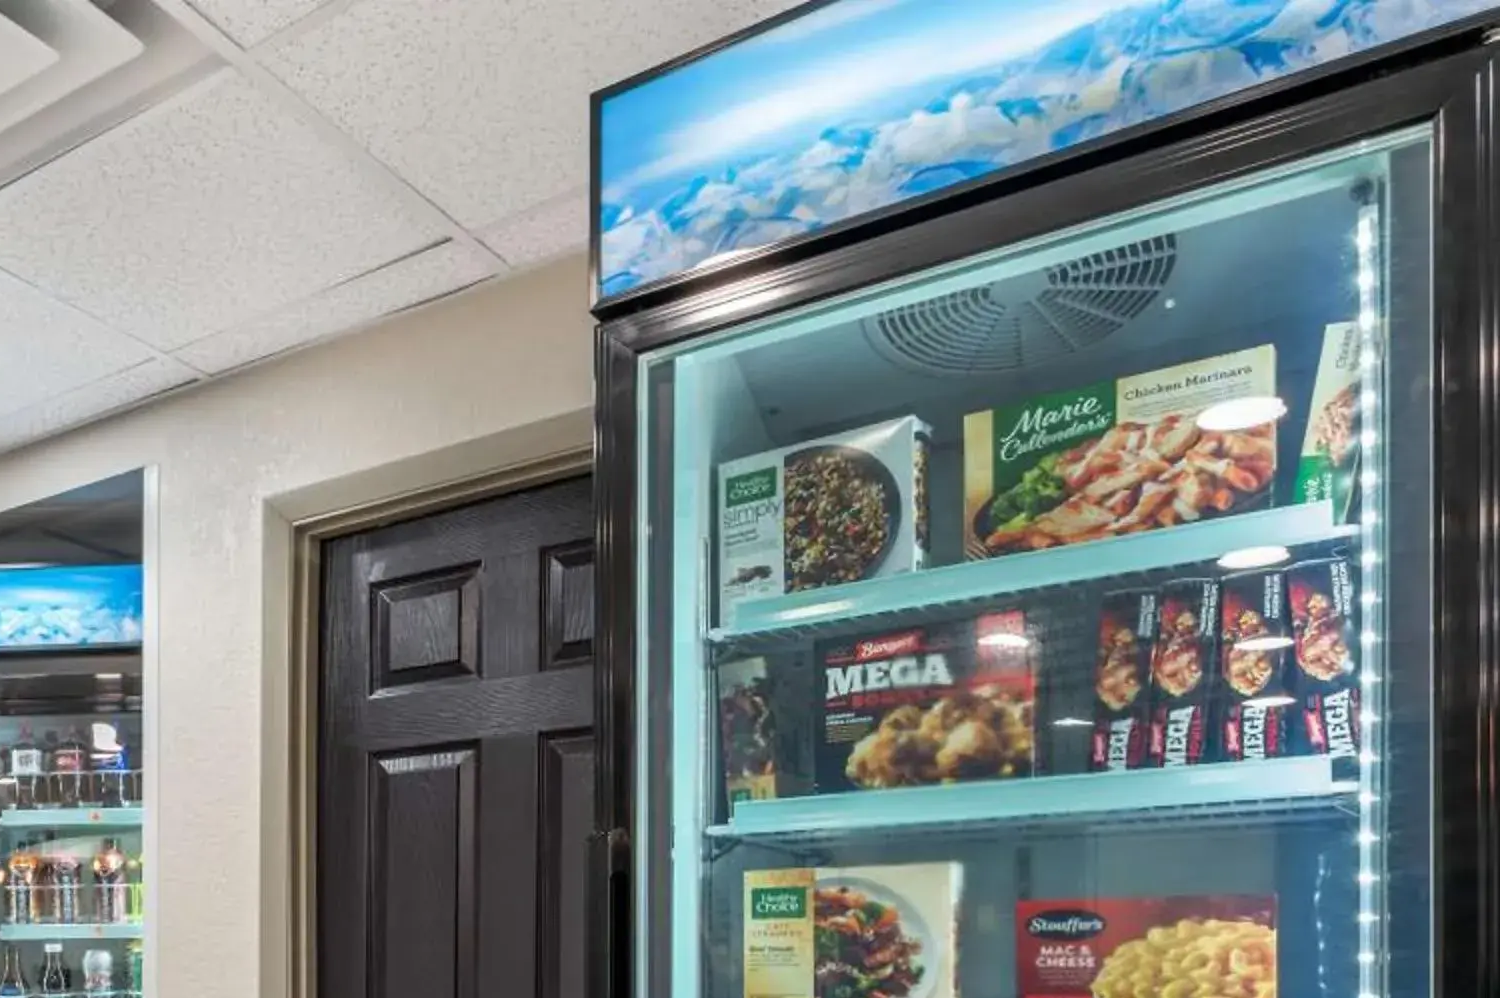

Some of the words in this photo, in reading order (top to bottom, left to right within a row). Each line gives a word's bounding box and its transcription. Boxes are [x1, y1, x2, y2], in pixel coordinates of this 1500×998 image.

[1124, 382, 1182, 401] Chicken
[1185, 365, 1253, 387] Marinara
[1000, 397, 1102, 442] Marie
[825, 653, 953, 699] MEGA
[1324, 688, 1356, 757] MEGA
[1035, 956, 1096, 968] CHEESE
[1041, 945, 1075, 956] MAC
